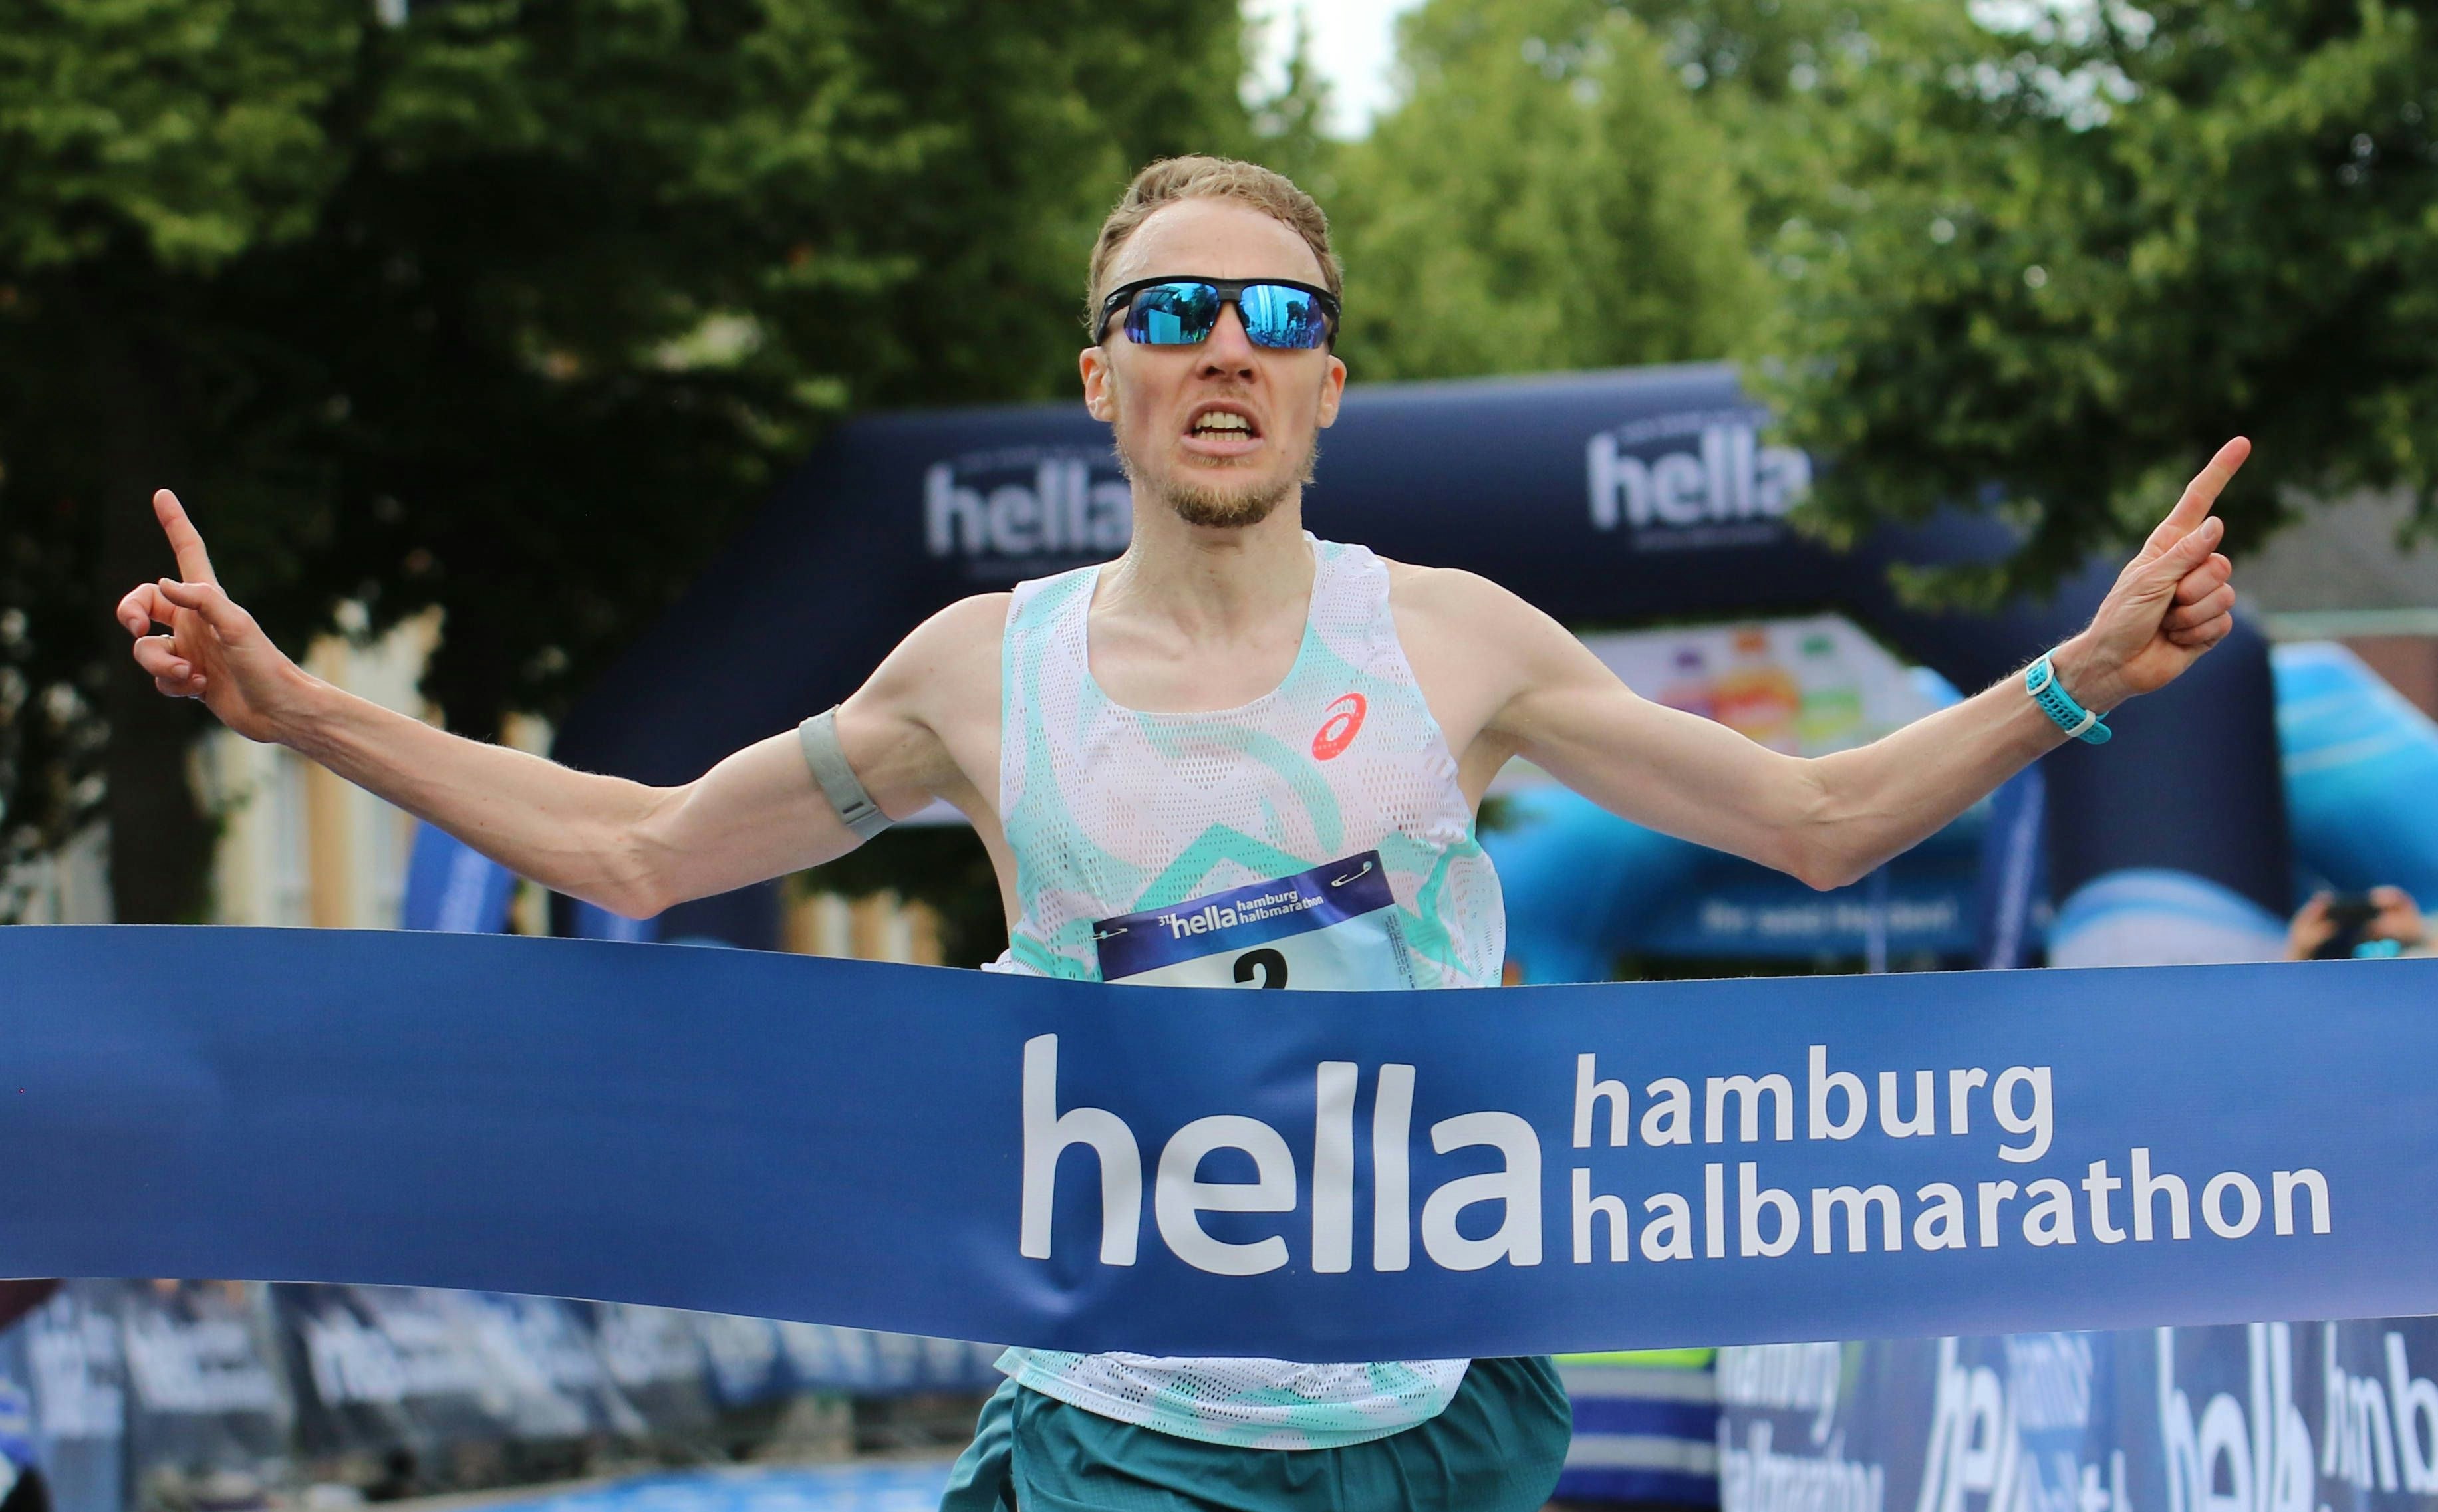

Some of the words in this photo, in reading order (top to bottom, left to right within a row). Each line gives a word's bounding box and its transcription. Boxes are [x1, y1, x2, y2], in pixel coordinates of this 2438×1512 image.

[924, 459, 1132, 553] hella
[1587, 427, 1812, 529] hella
[1170, 905, 1238, 940] hella
[1236, 890, 1299, 912] hamburg
[1239, 896, 1324, 924] halbmarathon
[1572, 1044, 2055, 1164] hamburg
[1021, 1032, 1543, 1276] hella
[1572, 1148, 2332, 1264] halbmarathon
